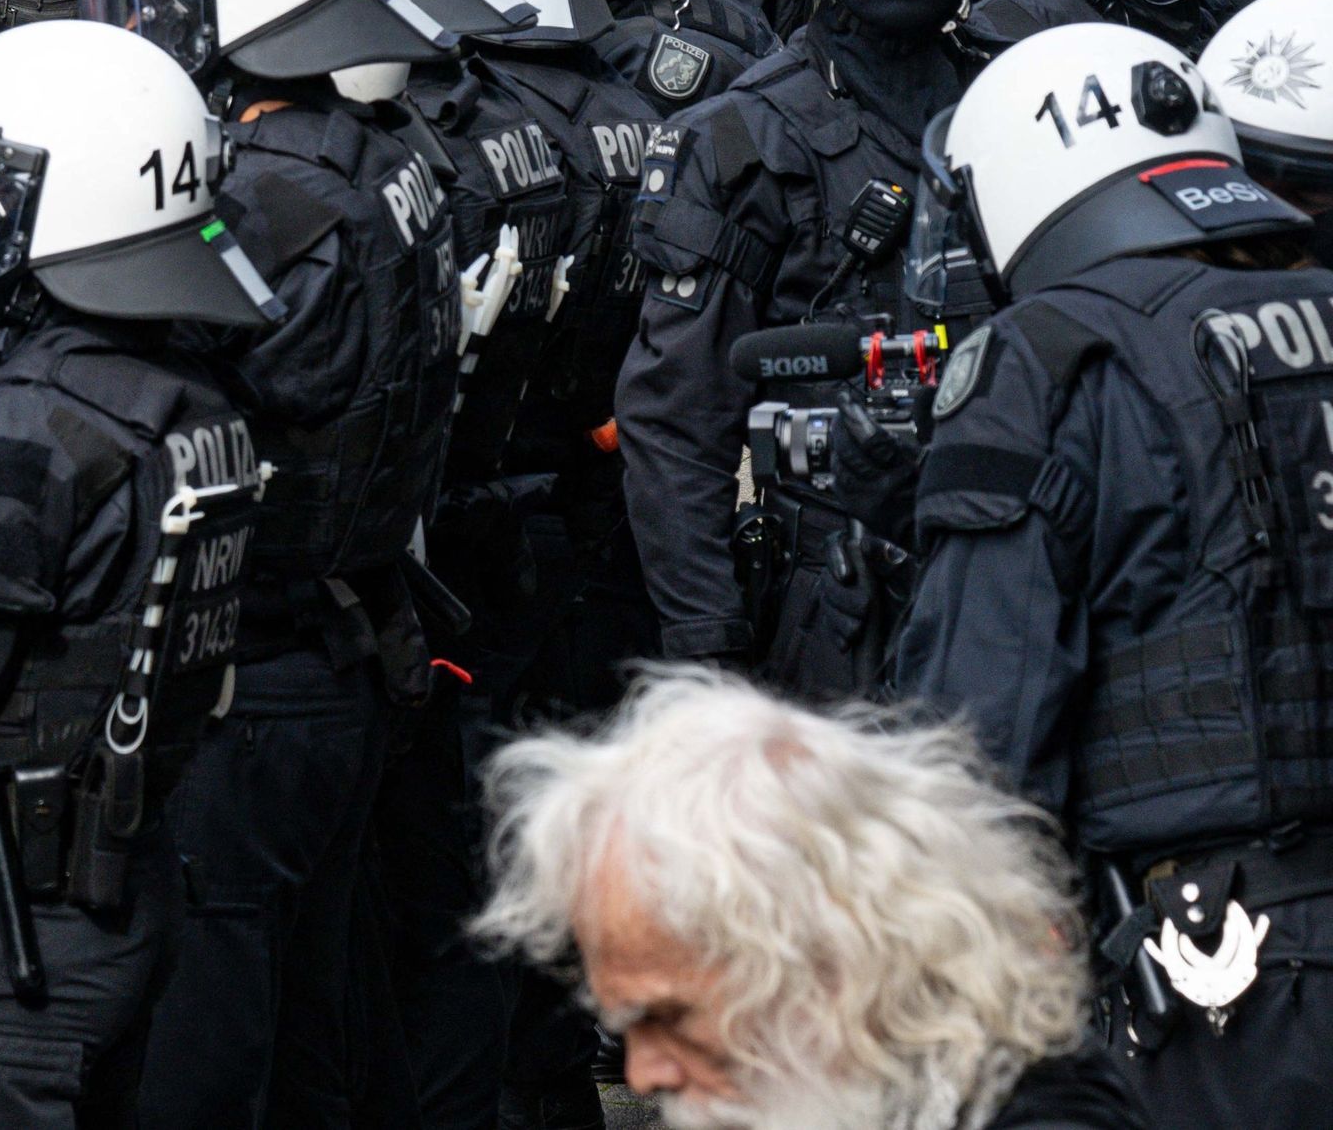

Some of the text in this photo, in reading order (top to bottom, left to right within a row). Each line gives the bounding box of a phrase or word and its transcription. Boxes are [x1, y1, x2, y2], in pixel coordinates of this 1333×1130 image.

[665, 37, 706, 60] POLIZEI
[1034, 73, 1124, 150] 14
[139, 139, 201, 212] 14
[1174, 182, 1269, 211] BeSi
[759, 355, 830, 378] RØDE
[190, 523, 250, 593] NRW
